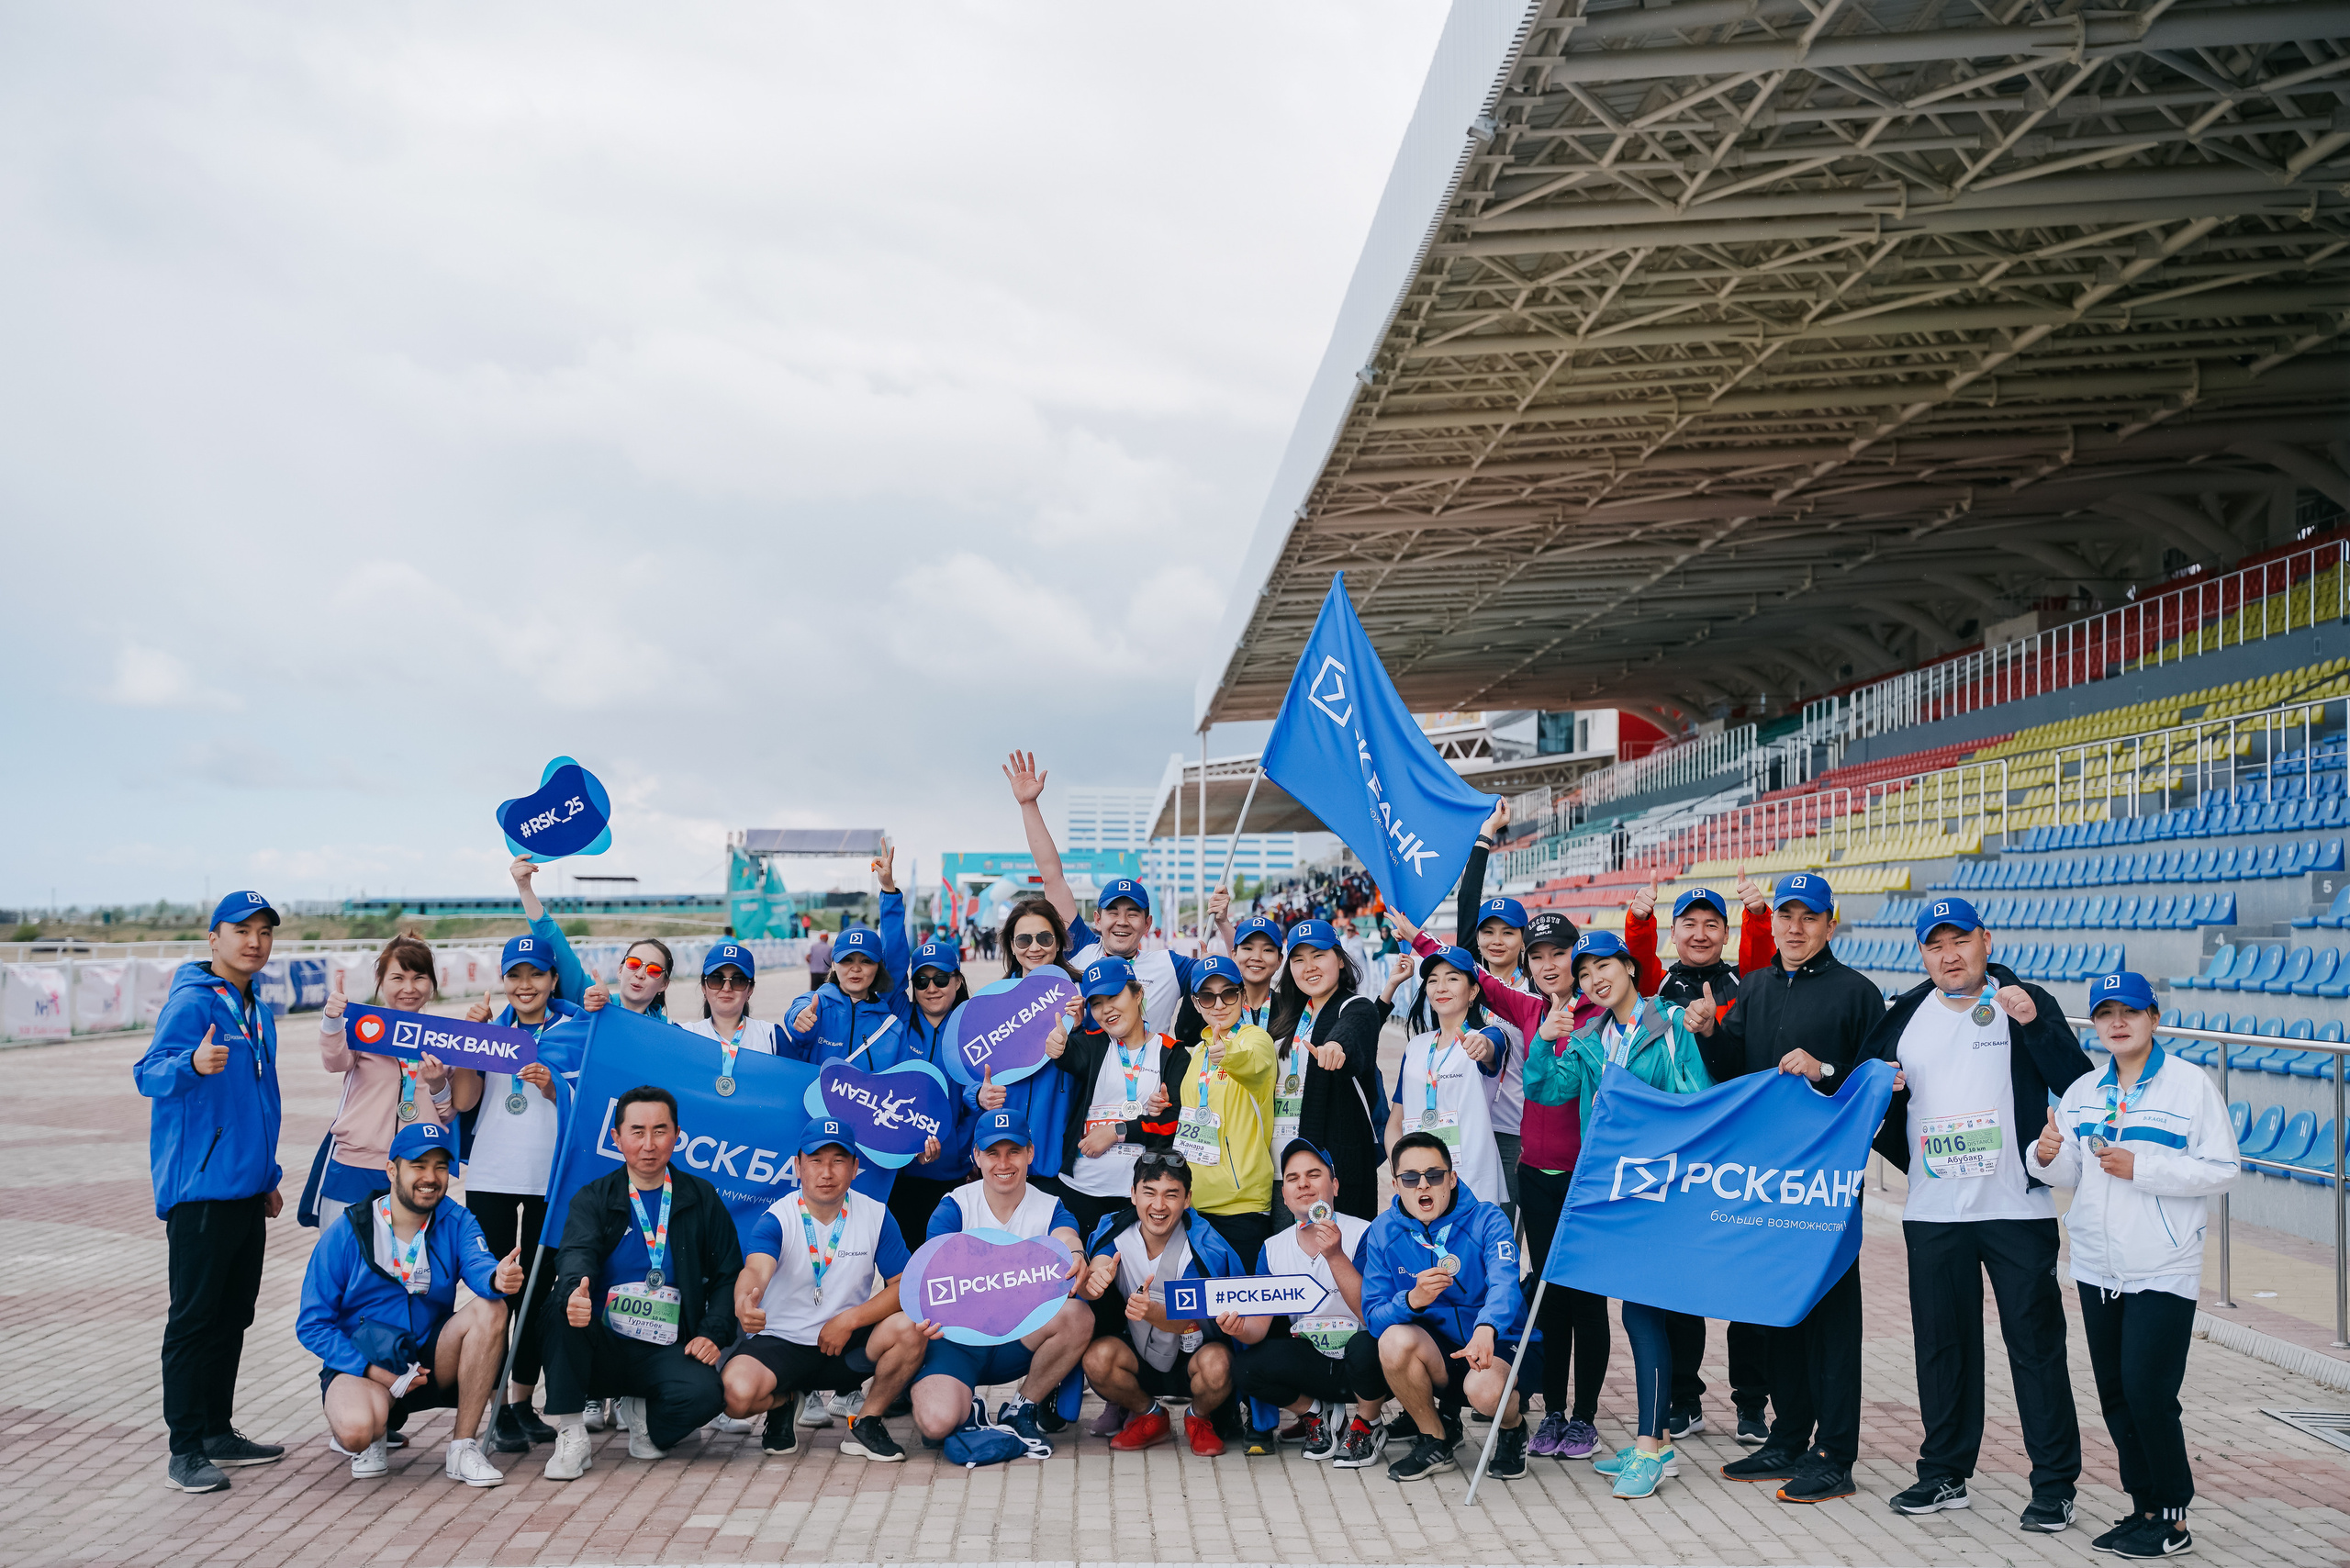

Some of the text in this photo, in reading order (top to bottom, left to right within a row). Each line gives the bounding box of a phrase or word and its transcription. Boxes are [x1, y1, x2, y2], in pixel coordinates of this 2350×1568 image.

[520, 795, 585, 838] #RSK_25
[2322, 879, 2333, 894] 5
[1528, 915, 1561, 931] LACOSTE
[2215, 932, 2225, 946] 4
[988, 983, 1066, 1047] RSK BANK
[422, 1030, 521, 1059] RSK BANK
[830, 1079, 941, 1136] RSK TEAM
[1175, 1122, 1200, 1139] 028
[1179, 1139, 1204, 1151] Жанара
[1924, 1135, 1966, 1155] 1016
[1966, 1138, 1994, 1147] DISTANCE
[1947, 1154, 1984, 1164] Абубакр
[1680, 1162, 1780, 1204] РСК
[1710, 1209, 1763, 1226] больше
[958, 1263, 1061, 1296] РСК БАНК
[1215, 1287, 1305, 1304] #РСК БАНК
[611, 1295, 653, 1316] 1009
[628, 1316, 663, 1329] Туратбек
